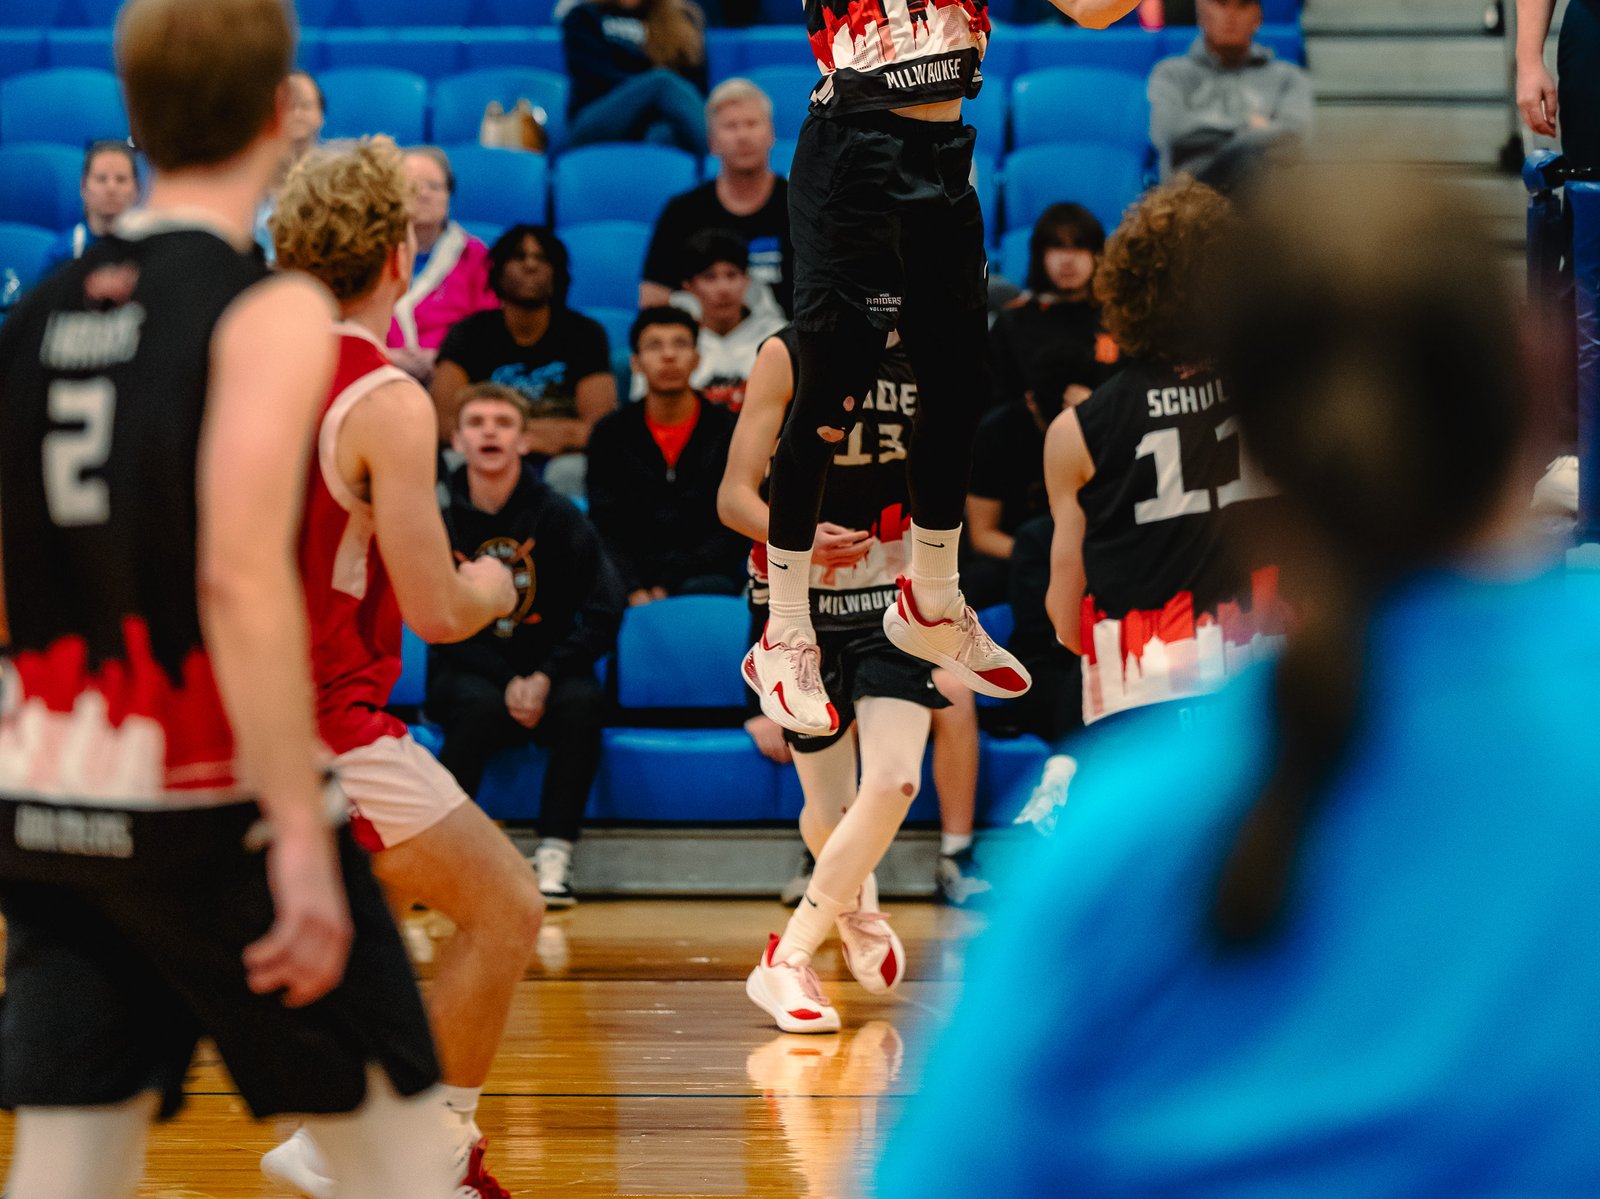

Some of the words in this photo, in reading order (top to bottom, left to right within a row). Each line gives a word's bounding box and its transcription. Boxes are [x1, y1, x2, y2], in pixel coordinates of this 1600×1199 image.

[883, 58, 962, 90] MILWAUKEE
[865, 296, 902, 306] RAIDERS
[41, 374, 117, 528] 2
[833, 421, 908, 466] 13
